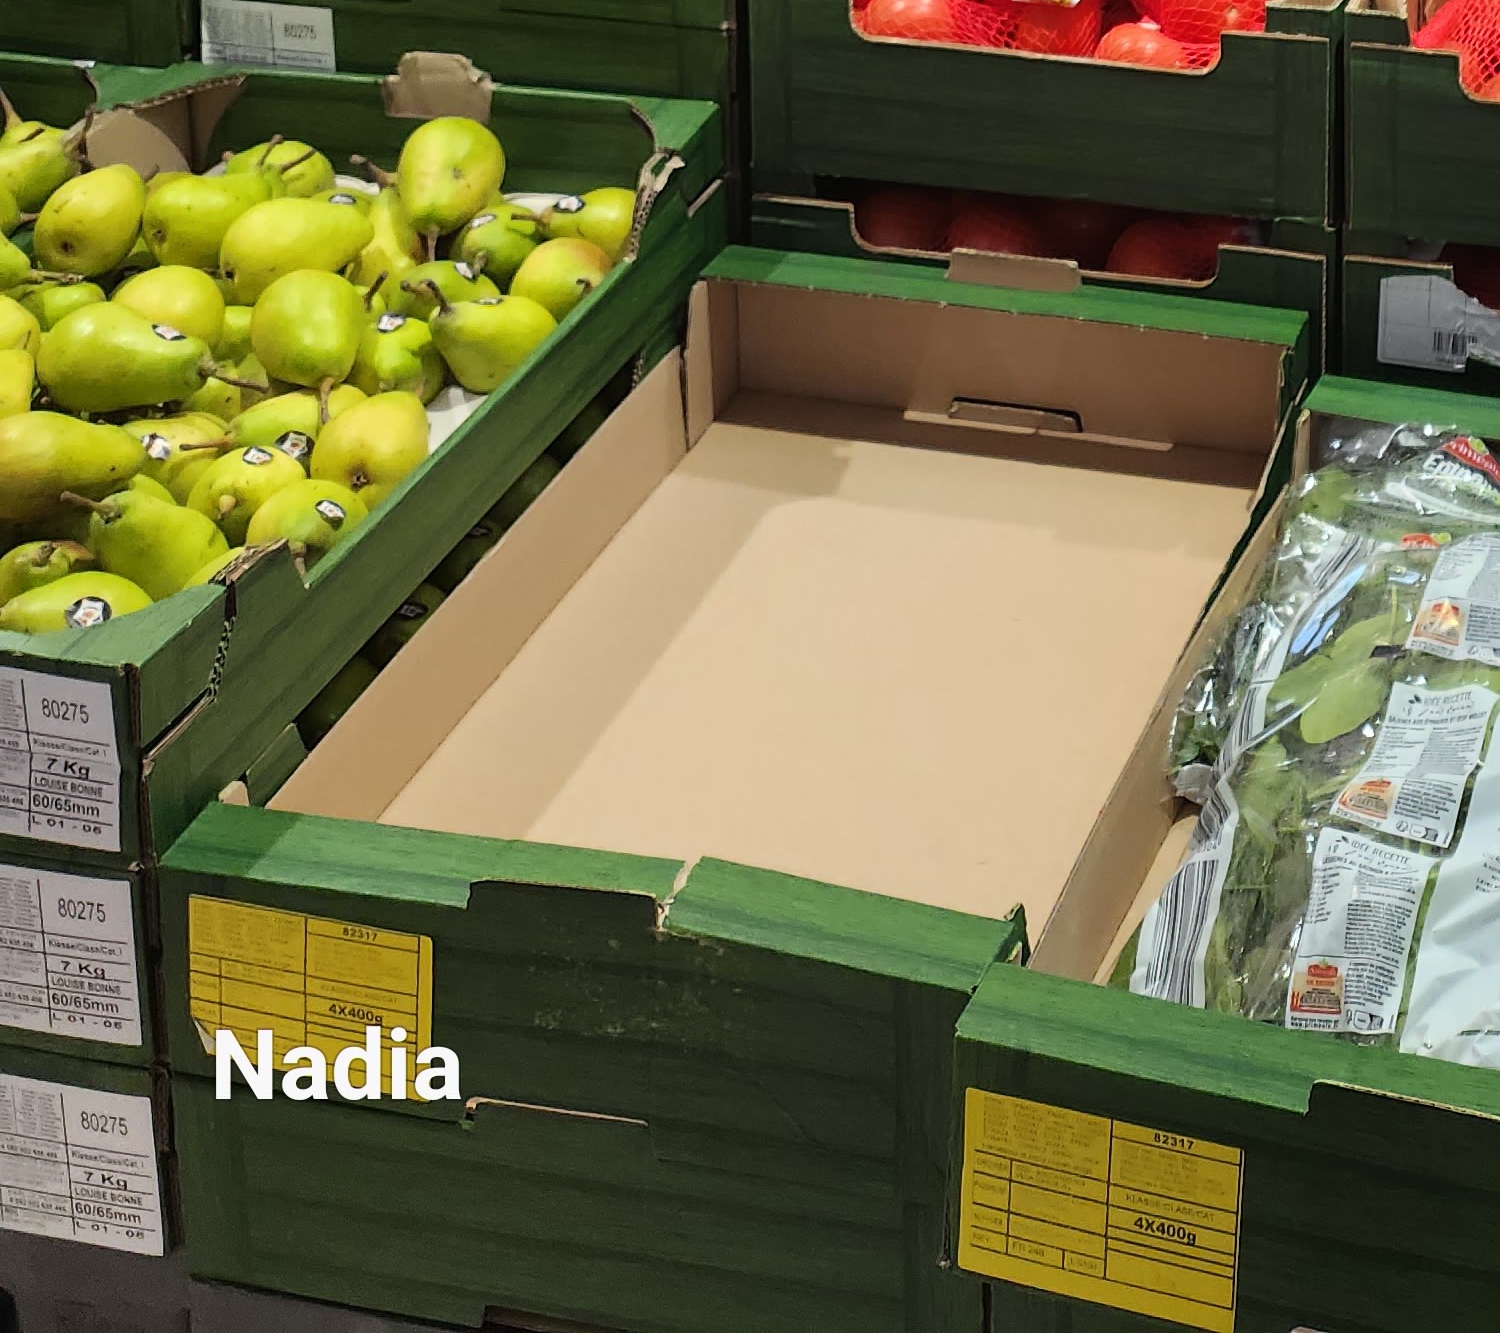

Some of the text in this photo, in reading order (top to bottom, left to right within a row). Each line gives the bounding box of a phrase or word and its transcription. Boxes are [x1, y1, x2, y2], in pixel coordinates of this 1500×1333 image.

[41, 698, 89, 725] 80275
[46, 758, 90, 779] 7 Kg
[34, 776, 103, 798] LOUISE BONNE
[32, 794, 100, 818] 60/65mm
[57, 898, 106, 923] 80275
[342, 926, 378, 943] 82317
[60, 960, 106, 979] 7 Kg
[52, 992, 120, 1014] 60/65mm
[80, 1111, 128, 1136] 80275
[1153, 1133, 1195, 1151] 82317
[83, 1171, 128, 1191] 7 Kg
[75, 1202, 141, 1224] 60/65mm
[1133, 1216, 1197, 1246] 4X400g
